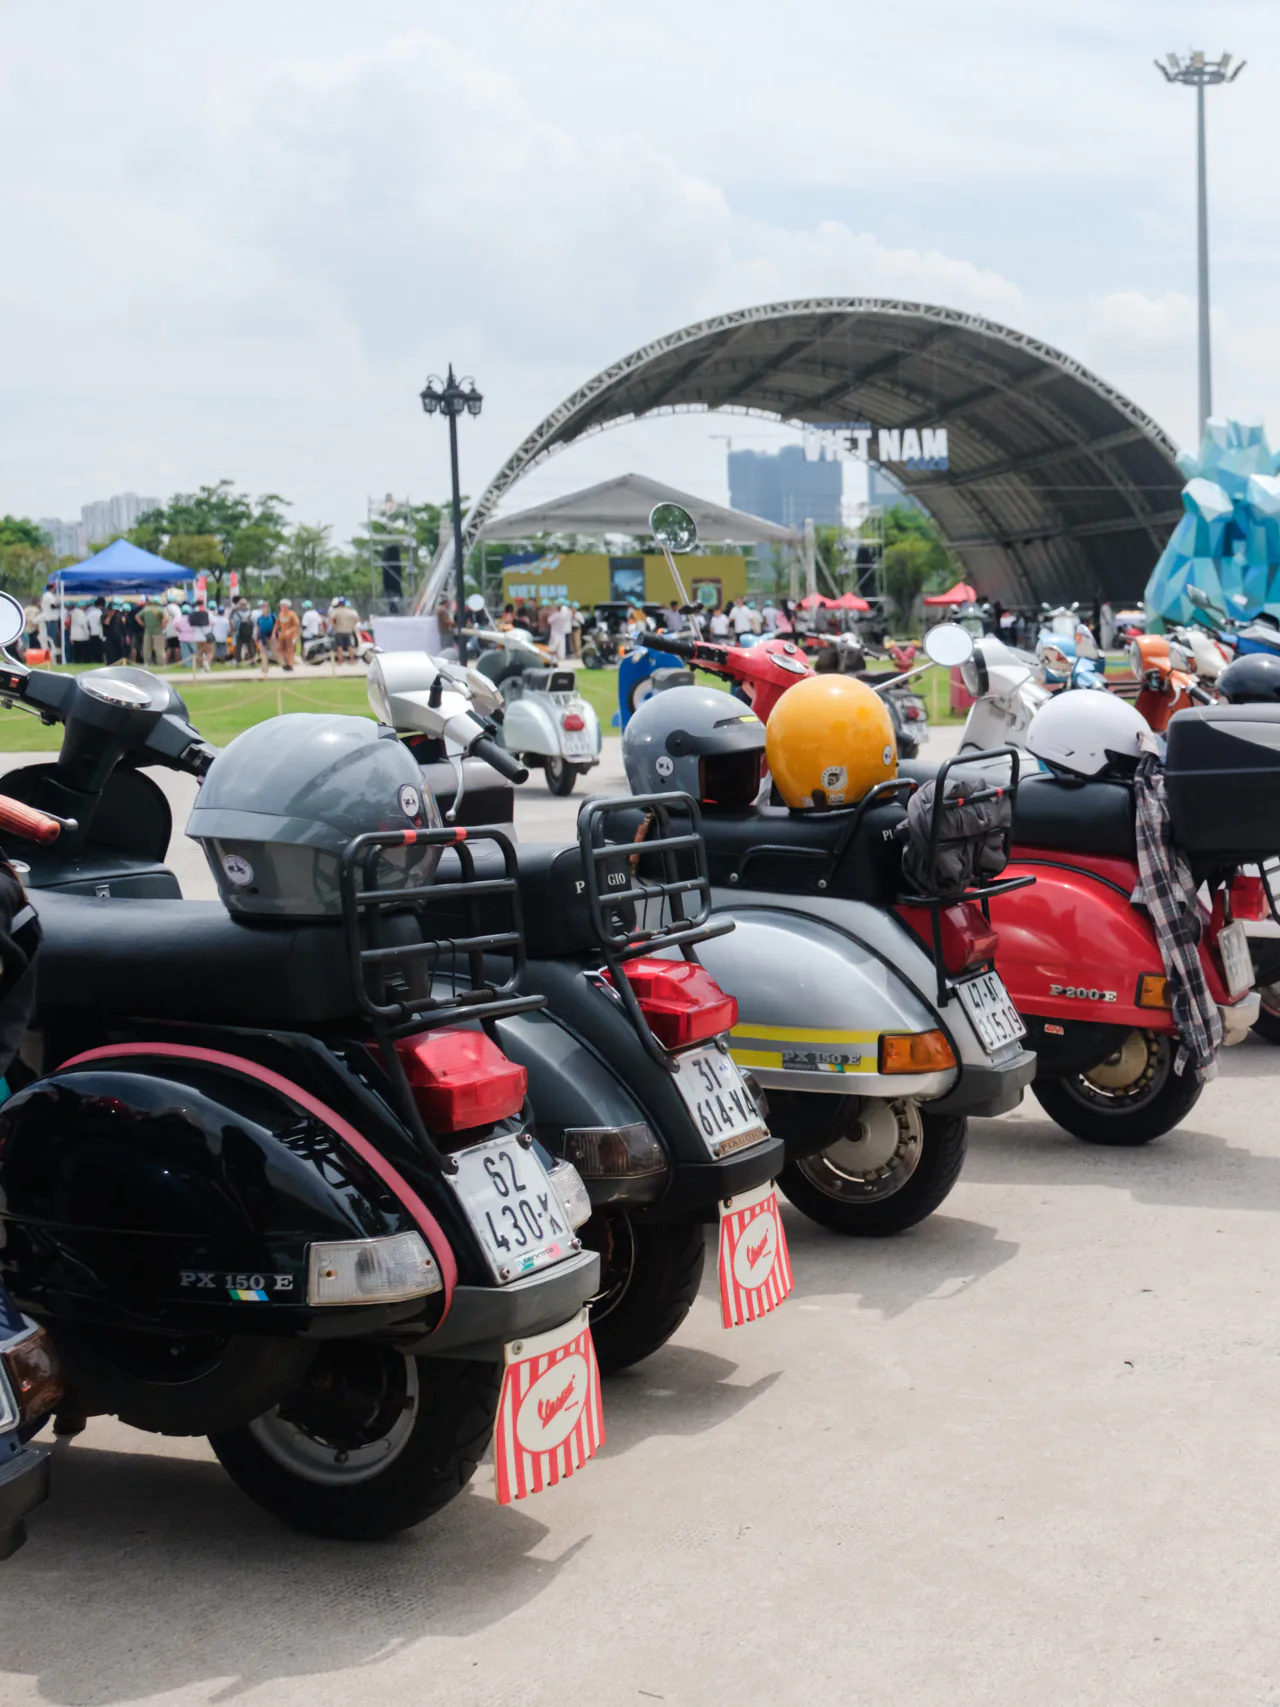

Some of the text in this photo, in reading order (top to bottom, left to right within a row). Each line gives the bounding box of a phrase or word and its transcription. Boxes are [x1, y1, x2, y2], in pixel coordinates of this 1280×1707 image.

[878, 428, 948, 461] NAM
[575, 872, 626, 894] PGIO
[692, 1057, 722, 1092] 31
[483, 1151, 526, 1197] 62
[180, 1272, 294, 1290] PX 150 E
